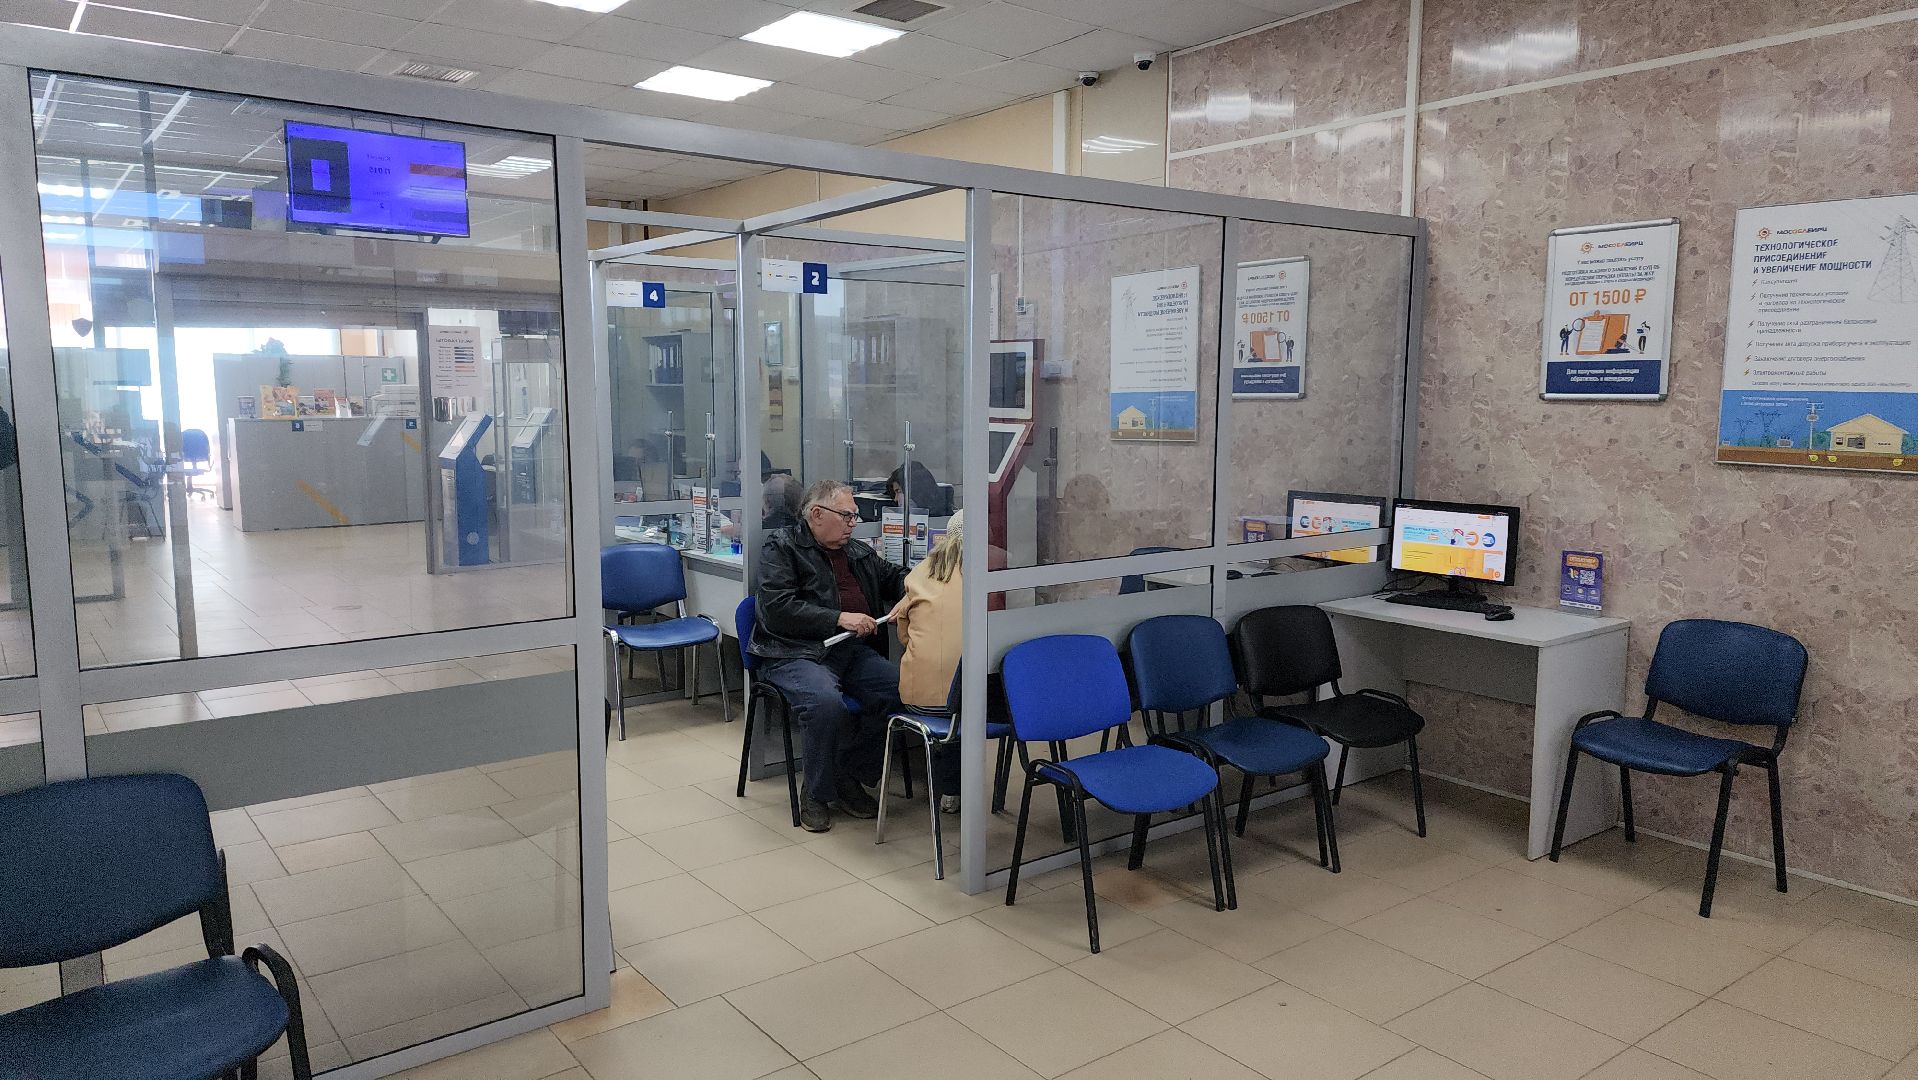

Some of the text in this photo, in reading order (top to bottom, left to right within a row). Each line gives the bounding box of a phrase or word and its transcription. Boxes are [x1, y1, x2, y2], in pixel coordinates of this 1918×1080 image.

[1755, 239, 1839, 251] ТЕХНОЛОГИЧЕСКОЕ
[1753, 251, 1827, 263] ПРИСОЕДИНЕНИЕ
[1753, 260, 1872, 274] И УВЕЛИЧЕНИЕ МОЩНОСТИ
[812, 271, 820, 286] 2
[649, 289, 659, 302] 4
[1569, 291, 1588, 306] ОТ
[1593, 289, 1631, 305] 1500
